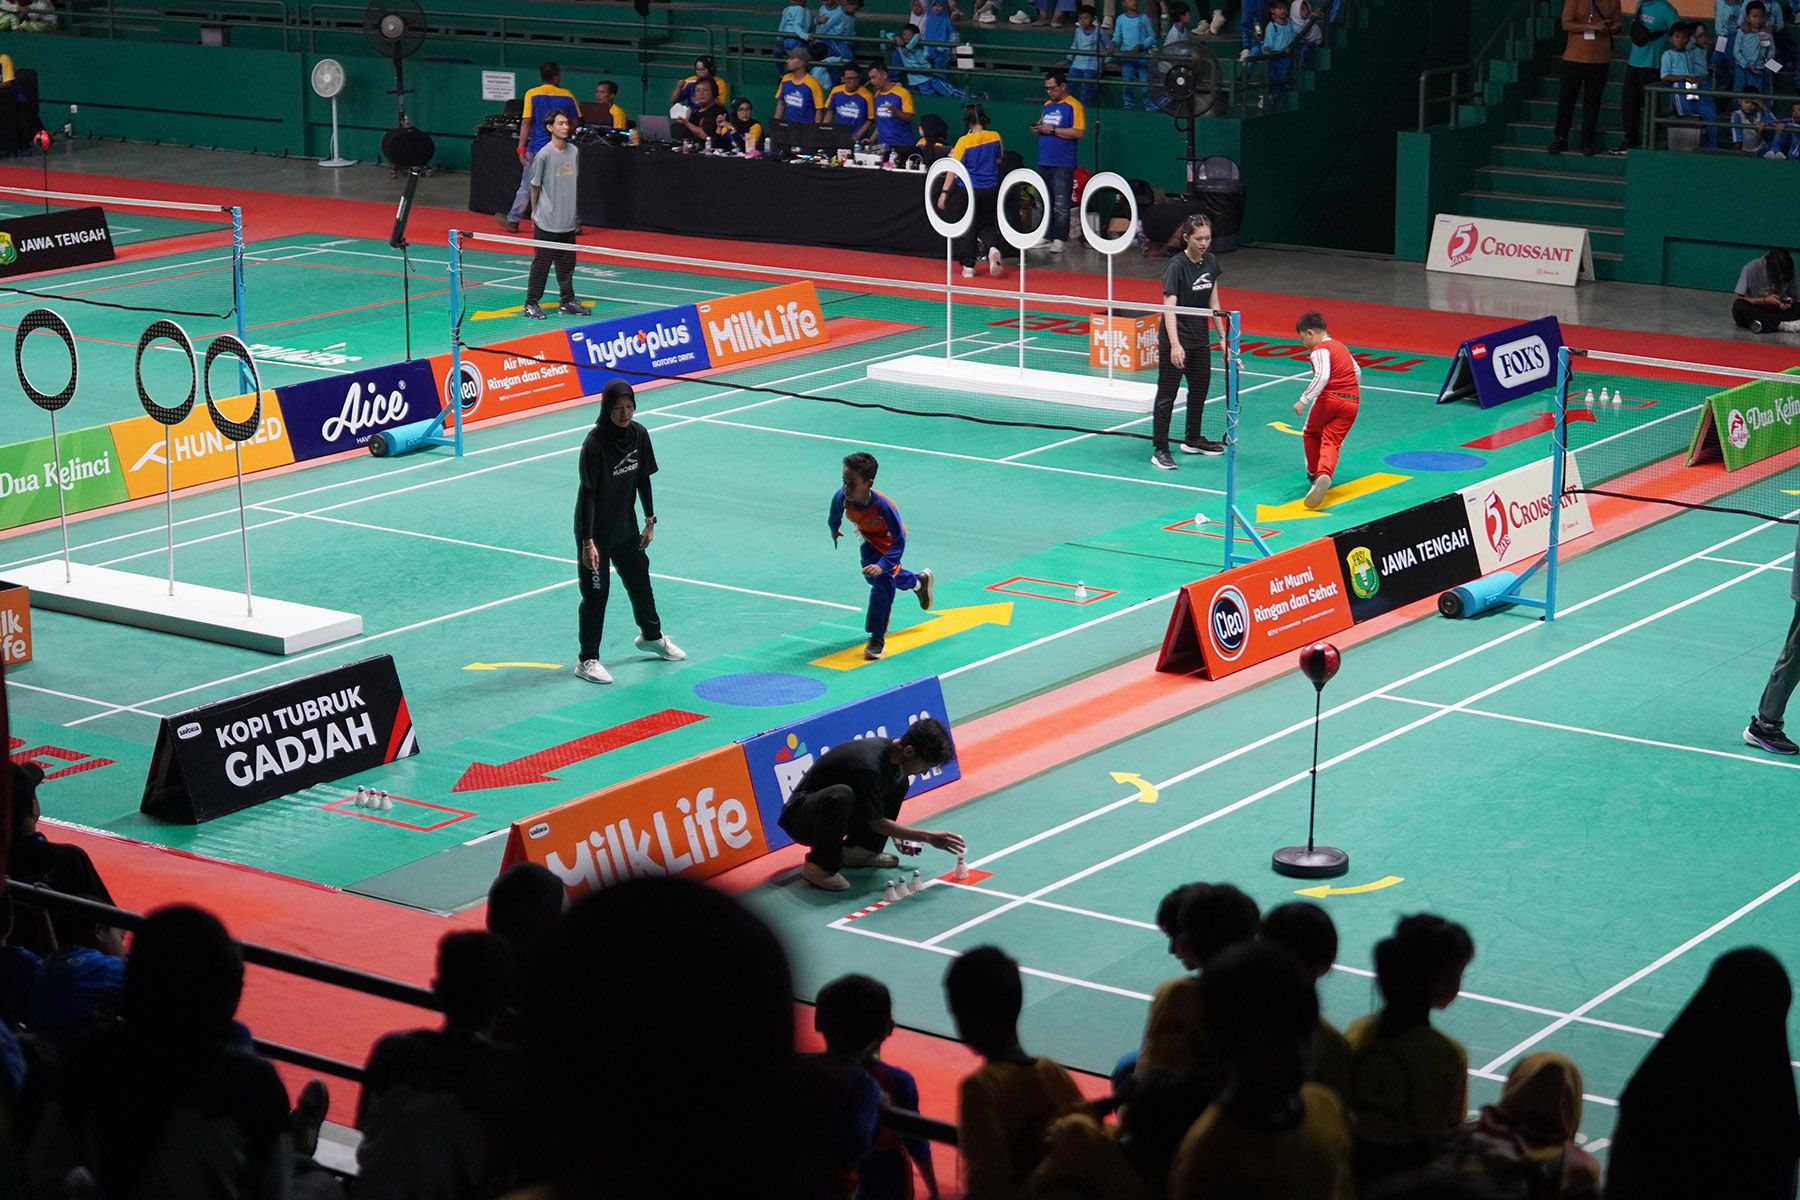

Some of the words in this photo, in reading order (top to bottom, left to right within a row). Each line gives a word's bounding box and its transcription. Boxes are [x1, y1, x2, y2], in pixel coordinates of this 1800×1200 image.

[20, 237, 54, 252] JAWA
[55, 228, 106, 247] TENGAH
[1480, 236, 1573, 263] CROISSANT
[1094, 329, 1130, 350] Milk
[503, 357, 517, 371] Air
[1099, 347, 1131, 368] Life
[1499, 344, 1545, 379] FOX'S
[487, 377, 521, 391] Ringan
[521, 371, 541, 383] dan
[540, 364, 569, 378] Sehat
[1746, 406, 1774, 431] Dua
[1774, 395, 1800, 425] Kelin
[174, 416, 283, 462] HUNED
[356, 436, 373, 445] HAV
[0, 472, 40, 498] Dua
[43, 450, 111, 491] Kelinci
[1381, 549, 1418, 576] JAWA
[1416, 527, 1470, 562] TENGAH
[1269, 578, 1284, 595] Air
[1284, 566, 1314, 590] Murni
[1253, 601, 1289, 623] Ringan
[1289, 594, 1309, 610] dan
[1308, 581, 1338, 603] Sehat
[0, 609, 23, 638] lk
[1215, 610, 1244, 640] Cleo
[215, 714, 272, 748] KOPI
[273, 685, 366, 731] TUBRUK
[225, 712, 377, 788] GADJAH
